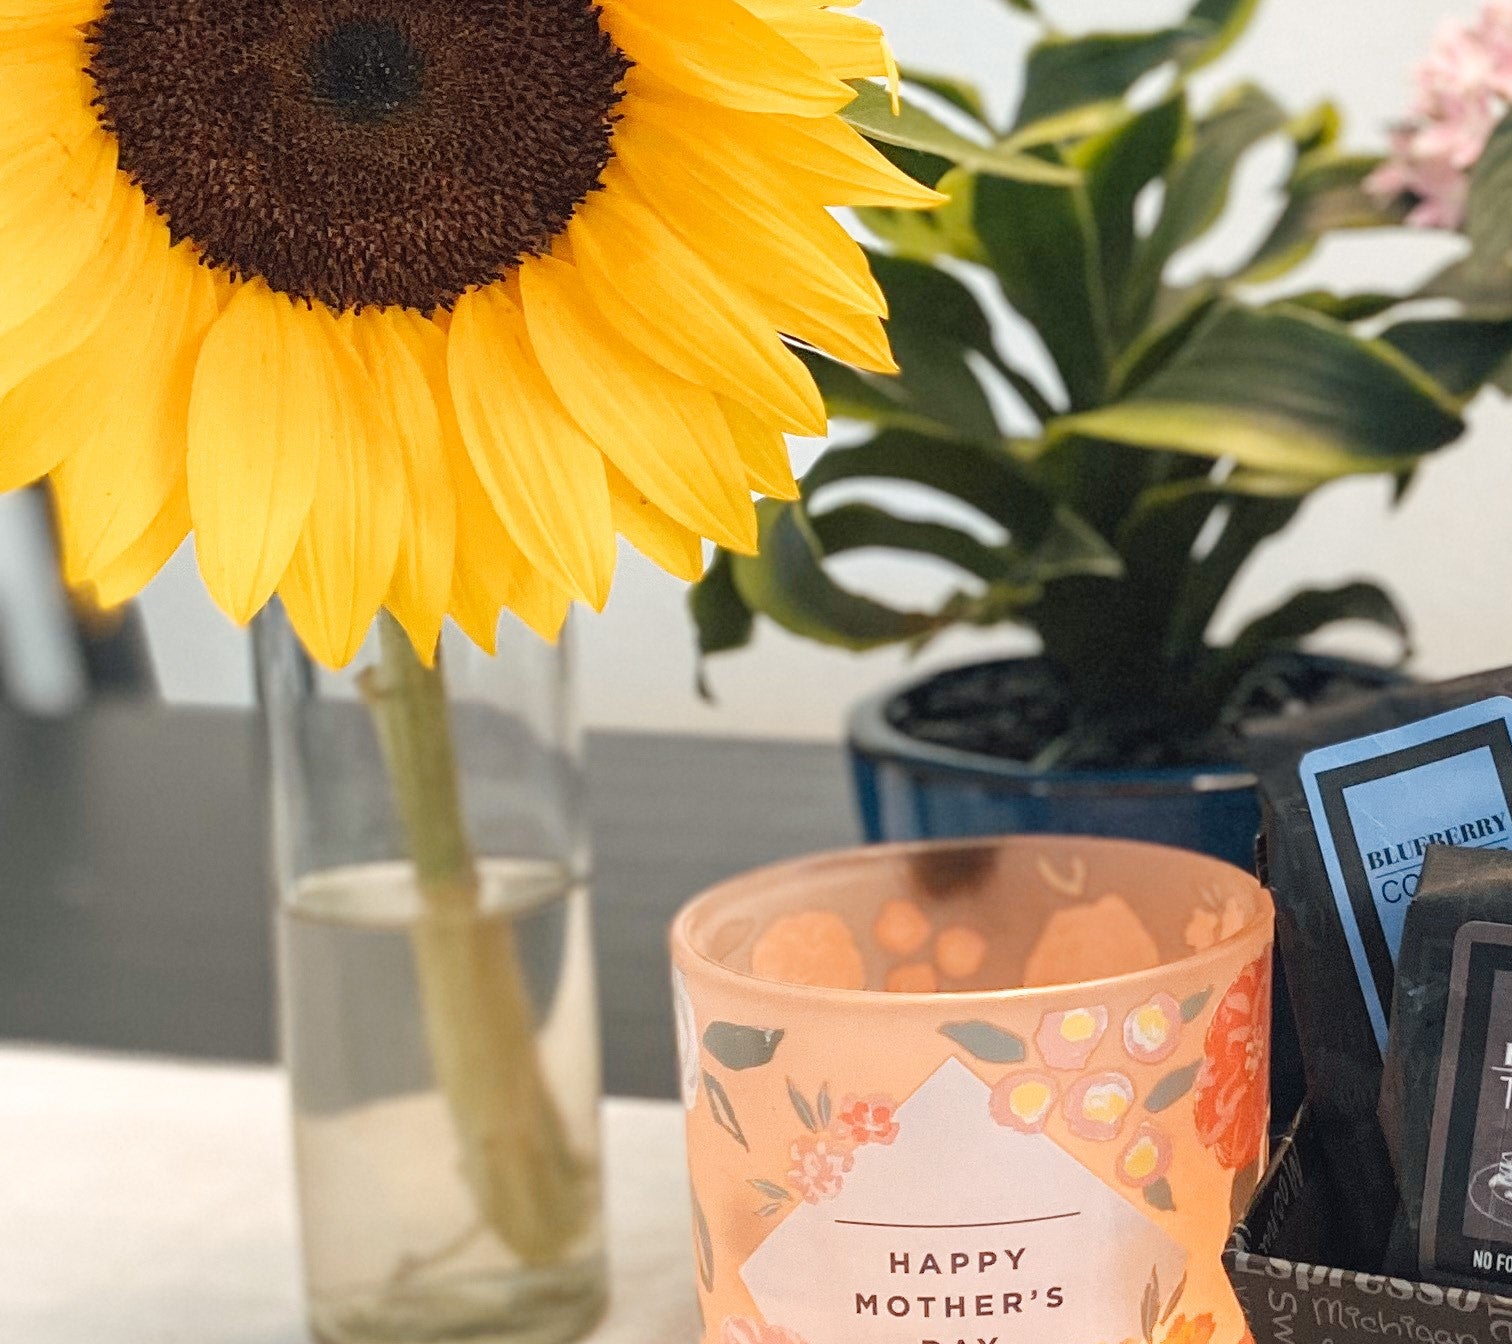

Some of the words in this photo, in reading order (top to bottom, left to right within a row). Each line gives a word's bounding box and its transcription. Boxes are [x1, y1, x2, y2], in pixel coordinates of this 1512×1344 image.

[1367, 812, 1507, 871] BLUEBERRY
[889, 1247, 1026, 1275] HAPPY
[1473, 1249, 1493, 1270] NO
[855, 1286, 1064, 1318] MOTHER'S
